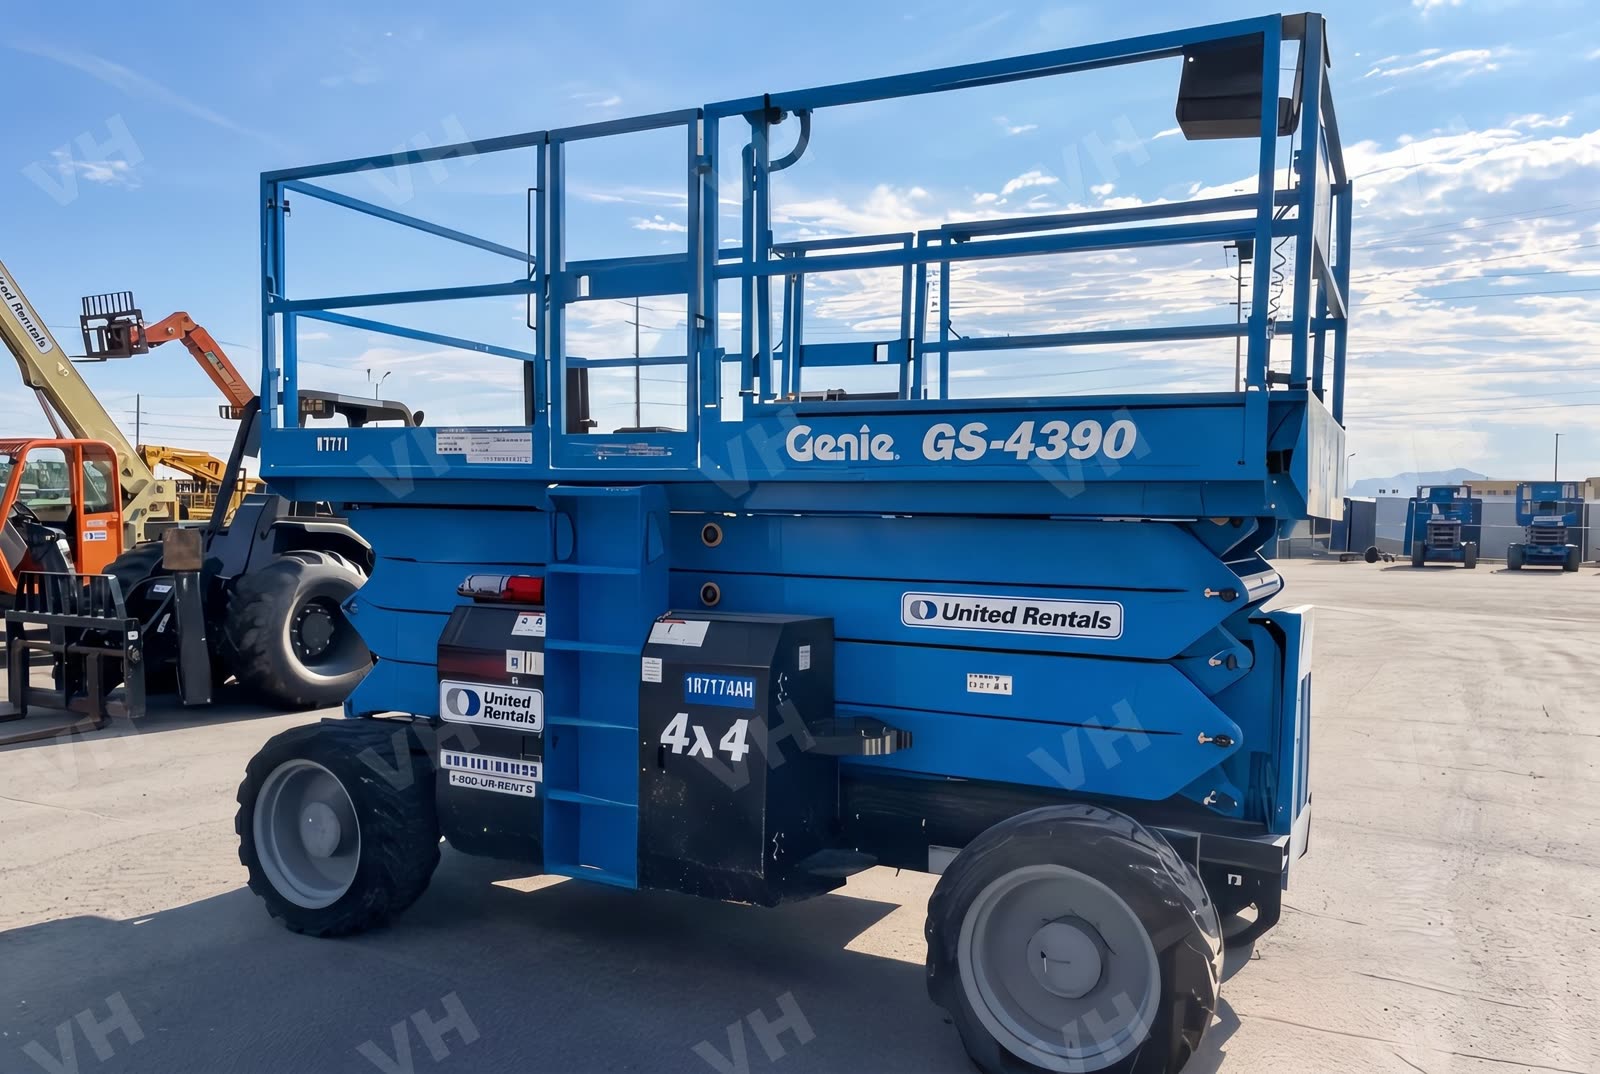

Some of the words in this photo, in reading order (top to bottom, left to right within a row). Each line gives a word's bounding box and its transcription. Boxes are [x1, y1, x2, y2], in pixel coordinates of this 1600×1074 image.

[11, 303, 46, 348] Rentals
[922, 419, 1137, 461] GS-4390
[942, 602, 1018, 625] United
[1022, 606, 1112, 630] Rentals
[484, 691, 532, 709] United
[483, 706, 536, 725] Rentals
[451, 774, 534, 794] 1-800-UR-RENTS
